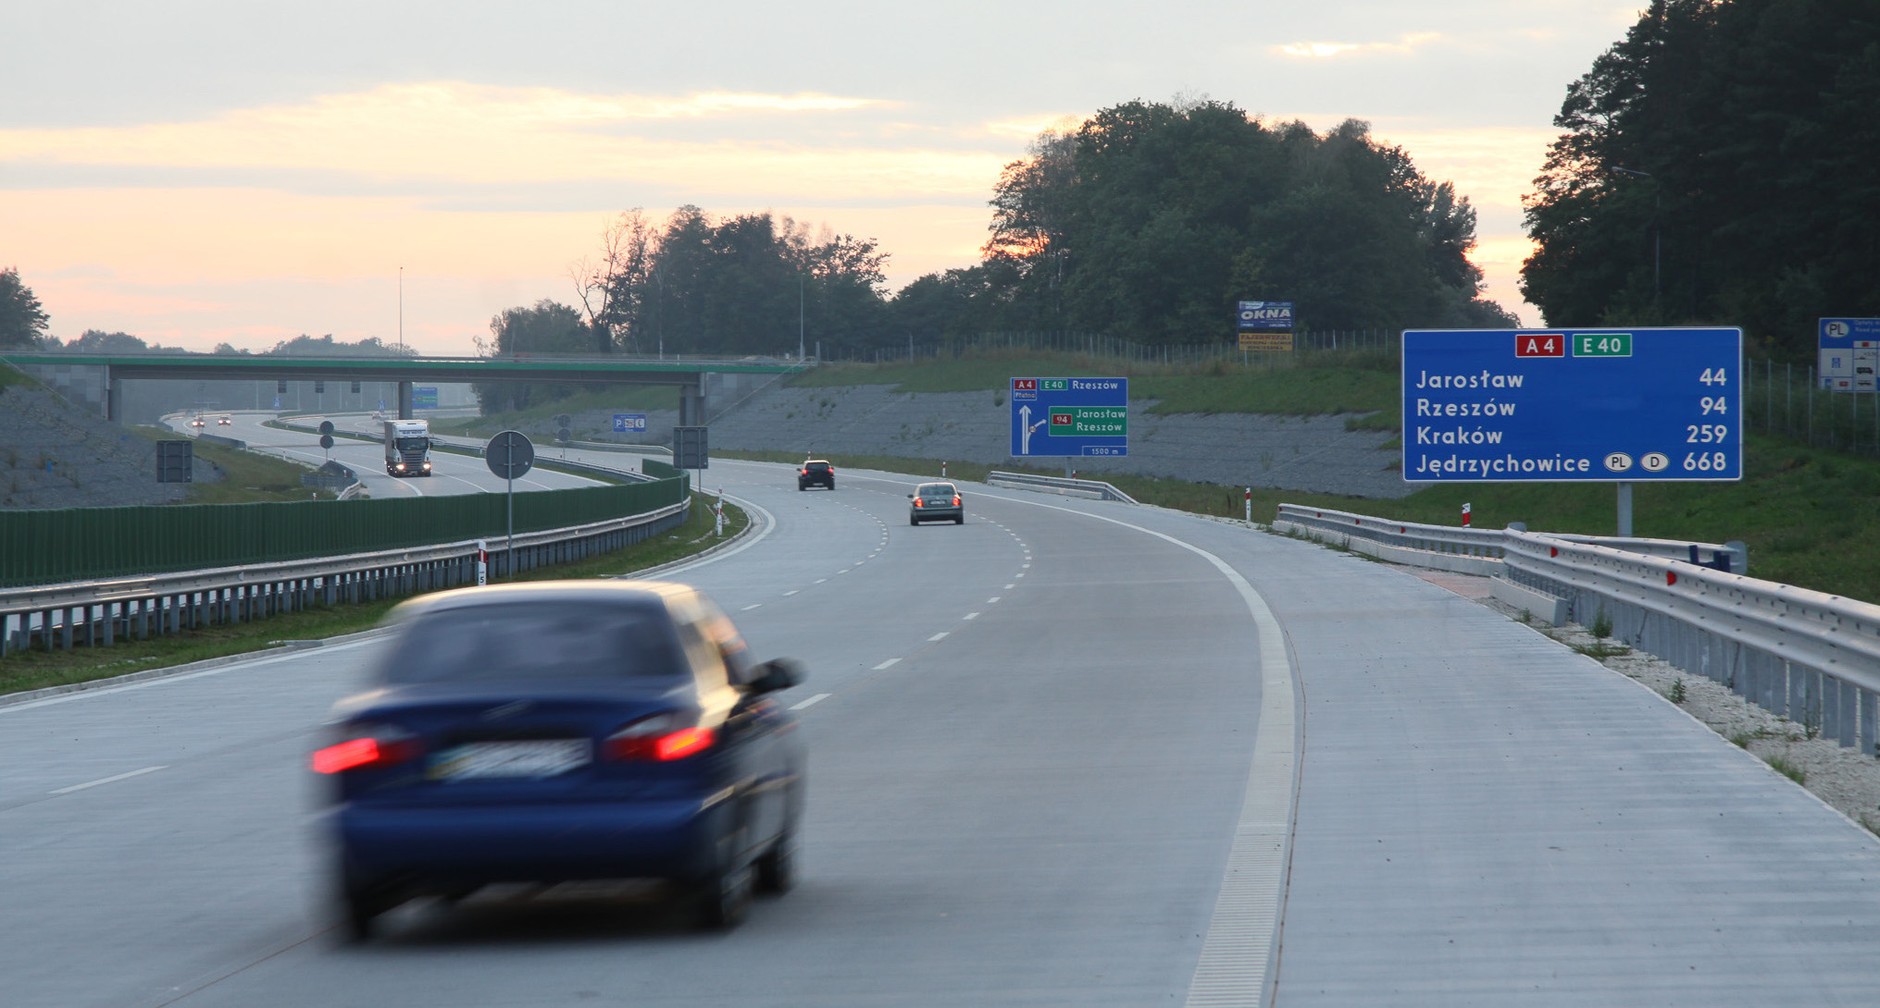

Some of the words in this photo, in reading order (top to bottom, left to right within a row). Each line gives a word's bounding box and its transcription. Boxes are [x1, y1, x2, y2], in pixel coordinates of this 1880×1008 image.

[1241, 309, 1291, 320] OKNA
[1829, 324, 1844, 335] PL
[1416, 370, 1523, 389] Jarosław
[1699, 368, 1727, 386] 44
[1073, 380, 1118, 389] Rzeszów
[1417, 398, 1515, 417] Rzeszów
[1700, 396, 1727, 415] 94
[1077, 409, 1125, 418] Jarosław
[1077, 422, 1122, 431] Rzeszów
[1417, 425, 1502, 444] Kraków
[1687, 424, 1727, 443] 259
[1416, 453, 1590, 477] Jędrzychowice
[1612, 457, 1625, 467] PL
[1651, 457, 1659, 467] D
[1683, 452, 1726, 471] 668
